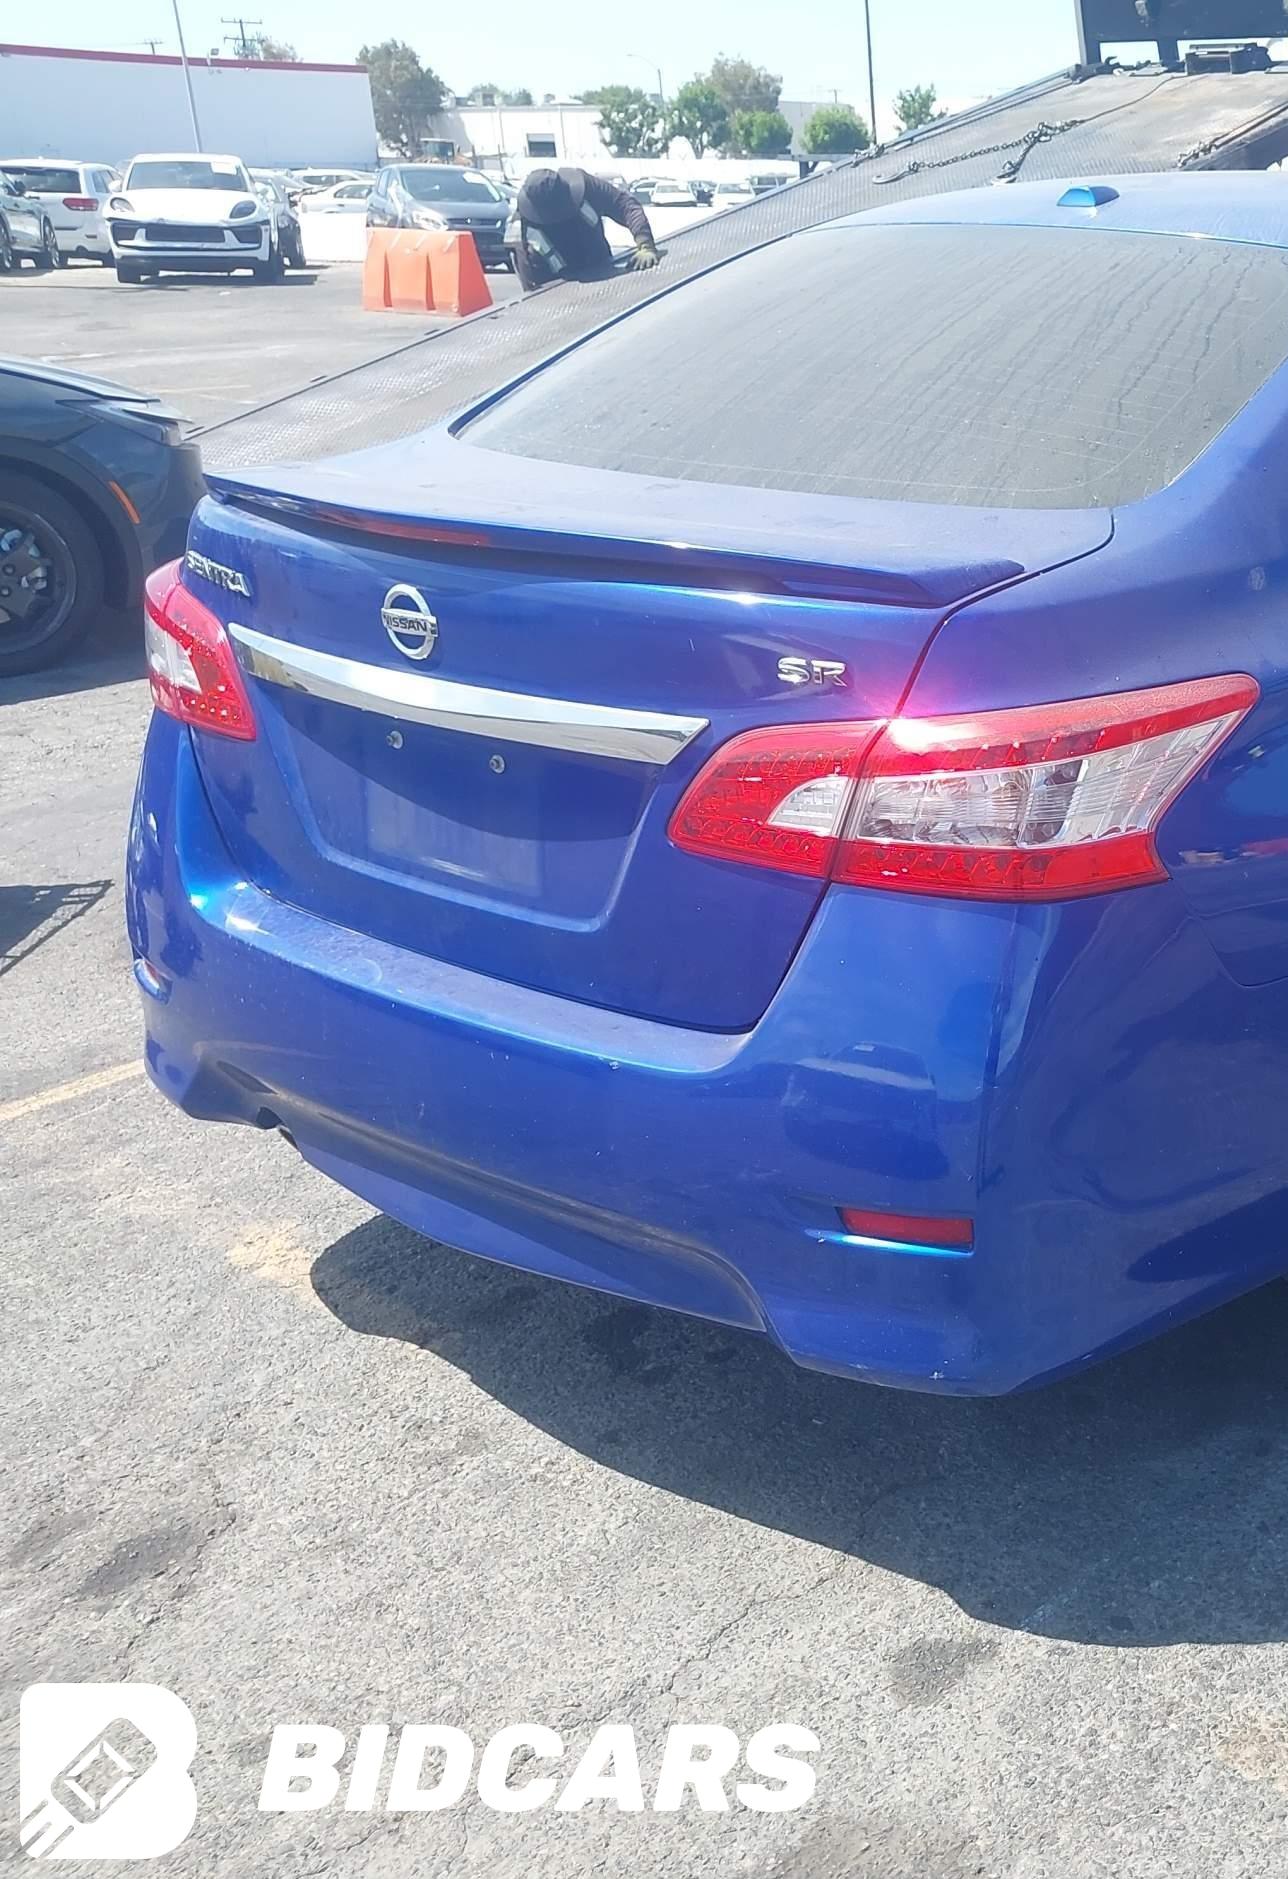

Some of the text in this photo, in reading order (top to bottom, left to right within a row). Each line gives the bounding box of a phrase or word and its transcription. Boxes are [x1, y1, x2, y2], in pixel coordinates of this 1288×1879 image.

[187, 550, 251, 597] SENTRA
[383, 614, 428, 632] NISSAN
[777, 657, 848, 688] SR
